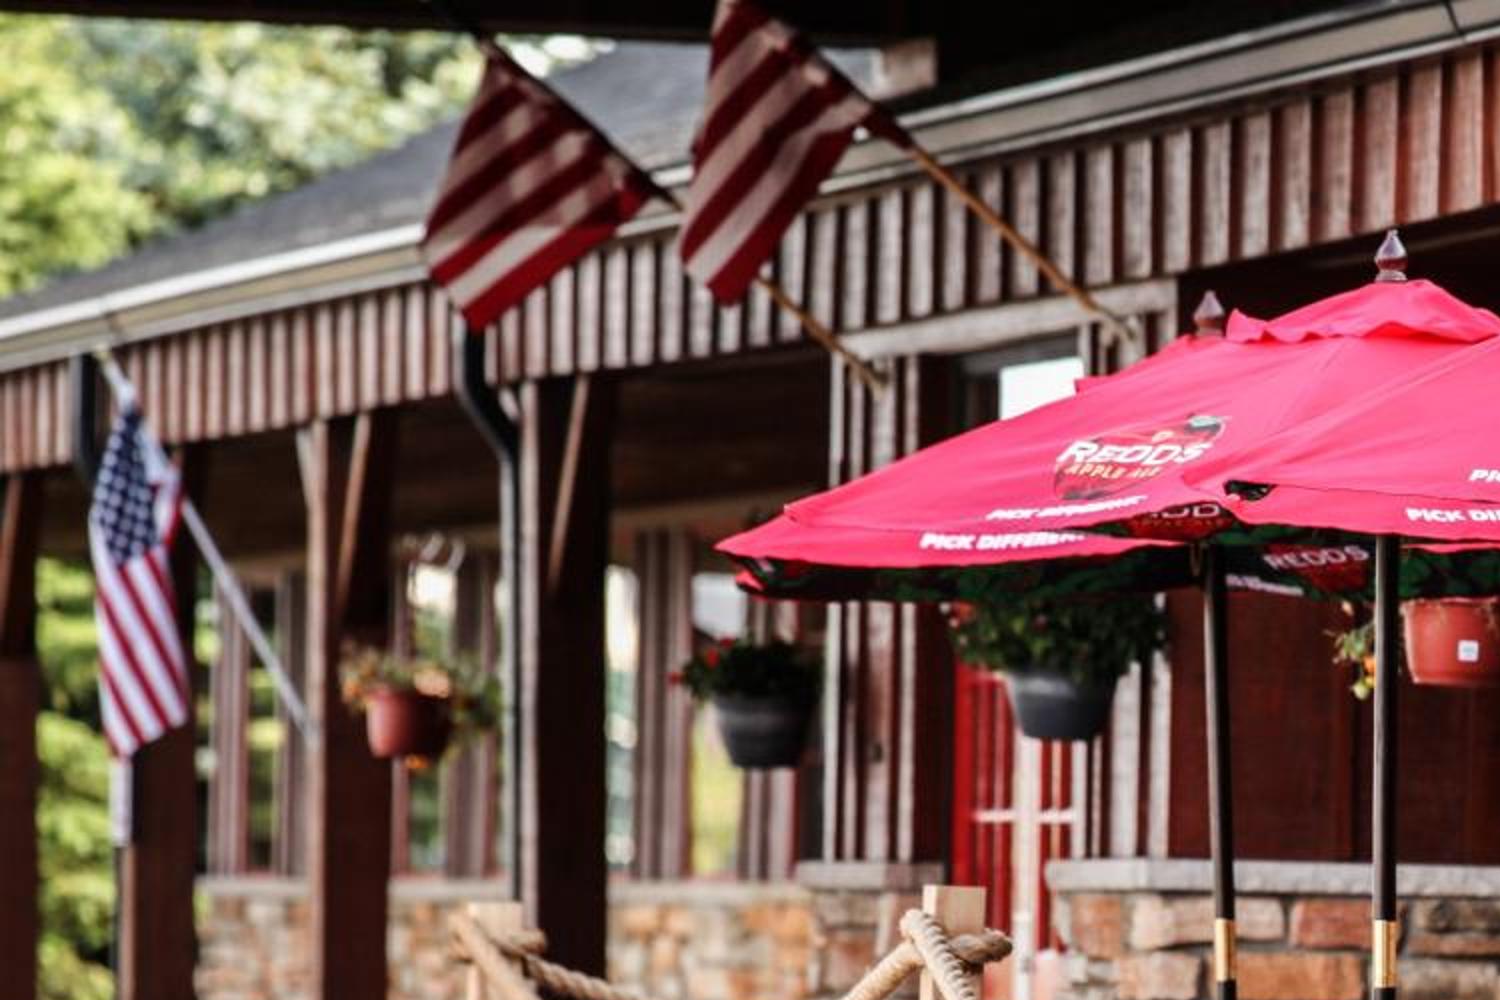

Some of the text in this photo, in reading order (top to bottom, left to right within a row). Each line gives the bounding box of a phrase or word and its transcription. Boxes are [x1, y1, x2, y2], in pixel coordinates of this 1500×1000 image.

[1064, 463, 1126, 479] APPLE
[1405, 507, 1466, 522] PICK
[920, 532, 976, 550] PICK
